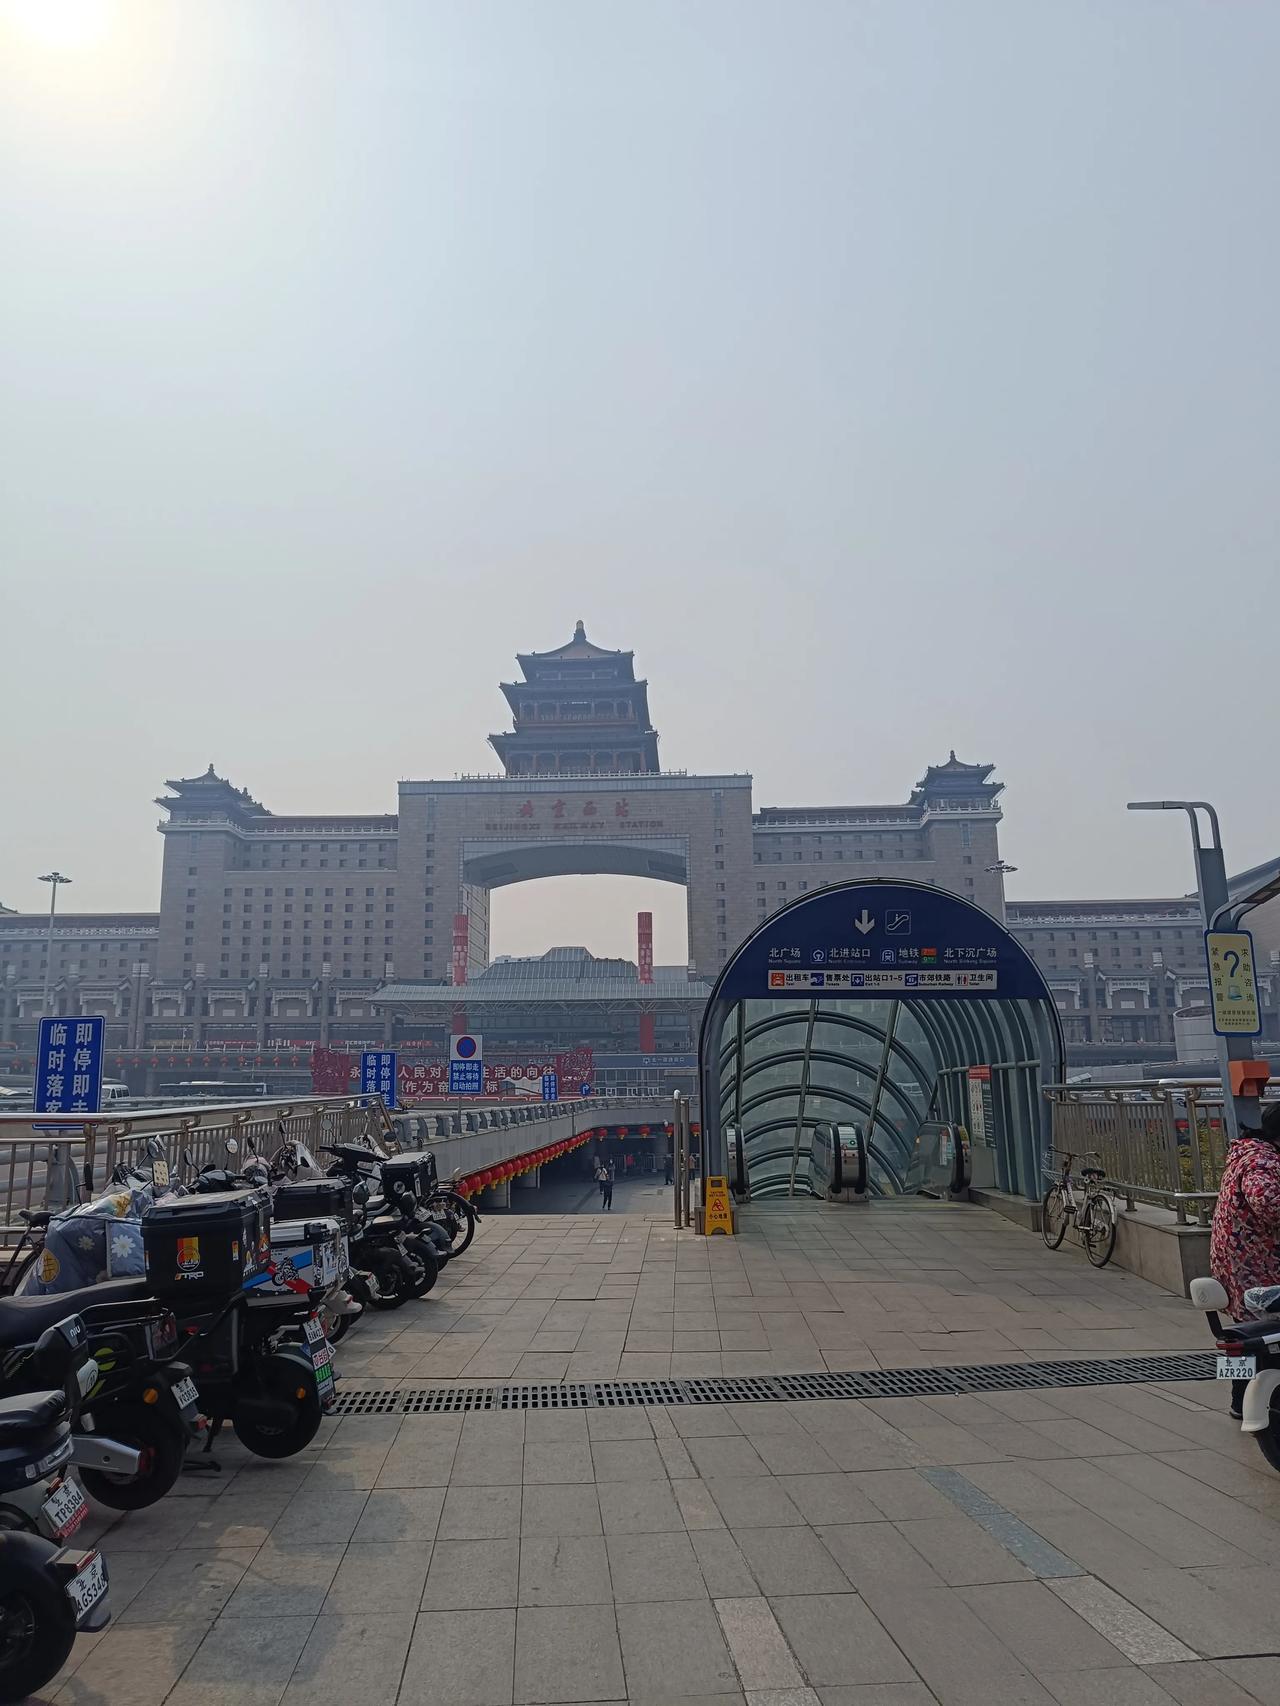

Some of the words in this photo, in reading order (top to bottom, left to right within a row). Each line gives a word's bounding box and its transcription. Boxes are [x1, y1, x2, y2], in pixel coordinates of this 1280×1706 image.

[769, 948, 801, 959] 北广场
[830, 948, 870, 959] 北进站口
[899, 948, 919, 958] 地铁
[944, 948, 997, 959] 北下沉广场
[786, 973, 809, 982] 出租车
[826, 973, 850, 982] 售票处
[919, 973, 951, 982] 市郊铁路
[969, 973, 993, 982] 卫生间
[1225, 1357, 1247, 1367] 北京
[1219, 1367, 1253, 1378] AZR220
[55, 1490, 83, 1523] TP8384
